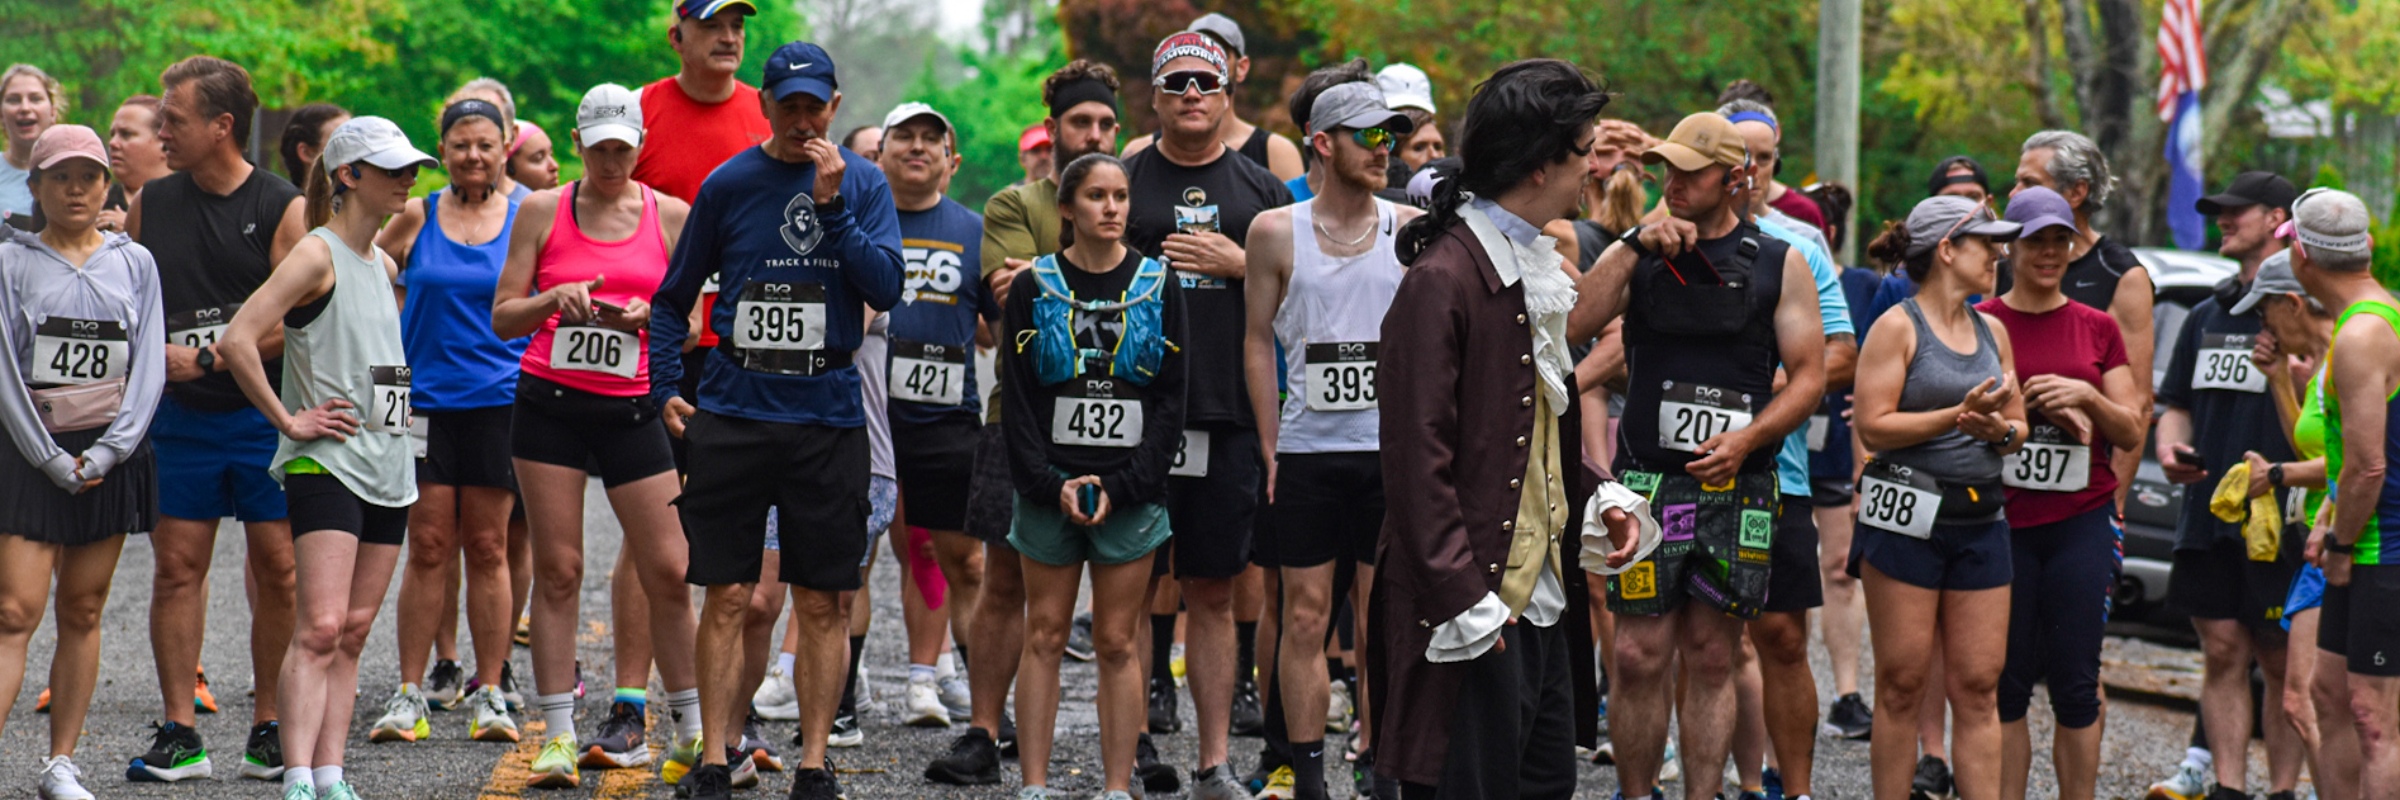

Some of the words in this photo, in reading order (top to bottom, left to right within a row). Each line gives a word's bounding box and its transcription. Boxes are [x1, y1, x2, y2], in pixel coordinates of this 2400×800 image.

[765, 258, 799, 267] TRACK
[803, 258, 809, 266] &
[813, 258, 840, 268] FIELD
[748, 306, 804, 343] 395
[50, 342, 109, 379] 428
[567, 331, 622, 367] 206
[905, 364, 949, 398] 421
[1323, 366, 1378, 403] 393
[2204, 353, 2250, 384] 396
[384, 389, 411, 428] 21
[1068, 402, 1124, 439] 432
[1673, 407, 1731, 445] 207
[2014, 447, 2071, 483] 397
[1866, 483, 1917, 526] 398
